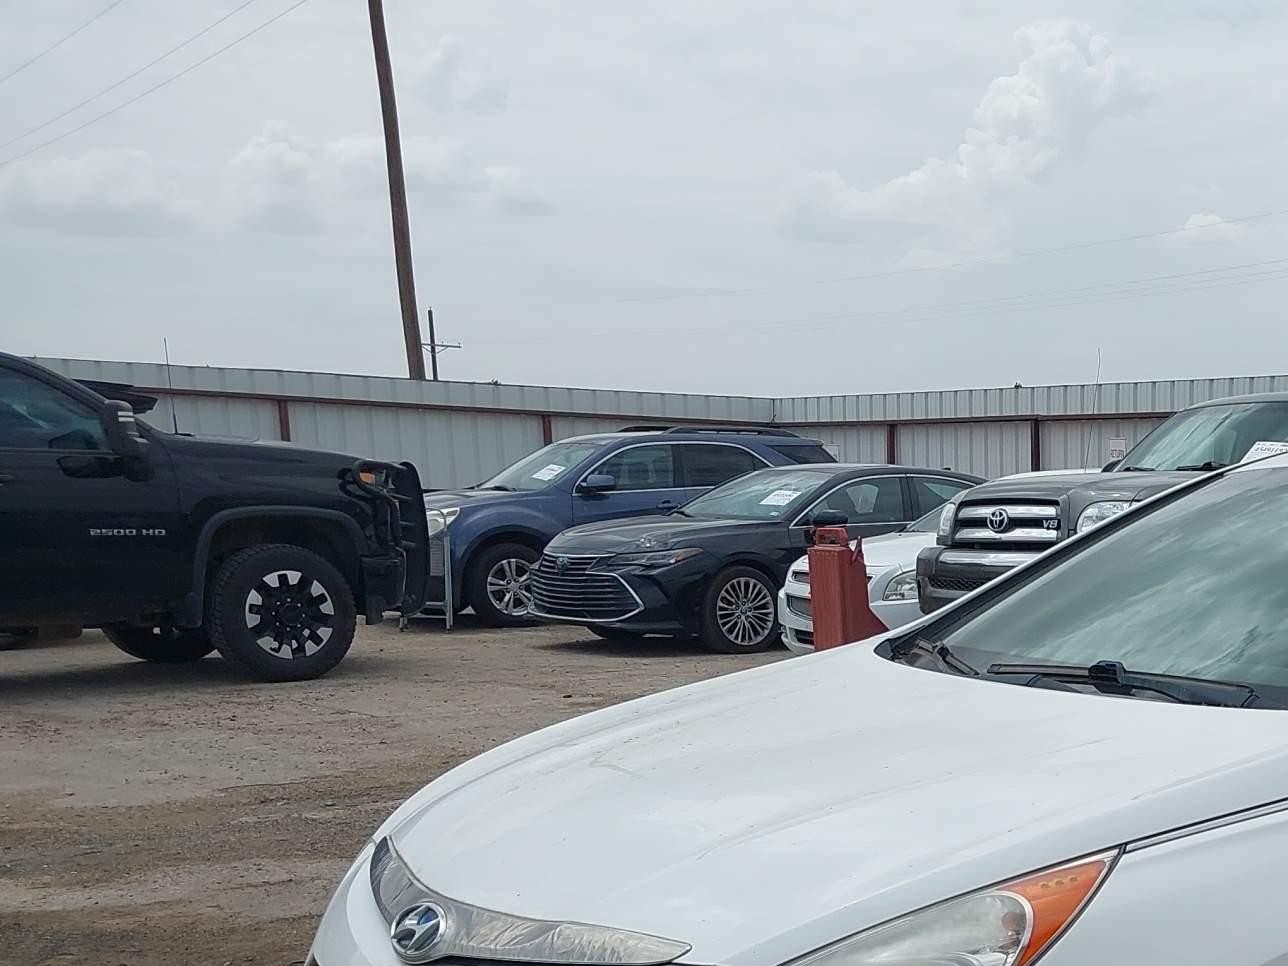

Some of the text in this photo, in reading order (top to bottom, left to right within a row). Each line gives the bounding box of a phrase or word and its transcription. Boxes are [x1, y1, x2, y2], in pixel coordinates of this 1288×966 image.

[1042, 519, 1059, 529] V8
[89, 528, 166, 536] 2500 HD
